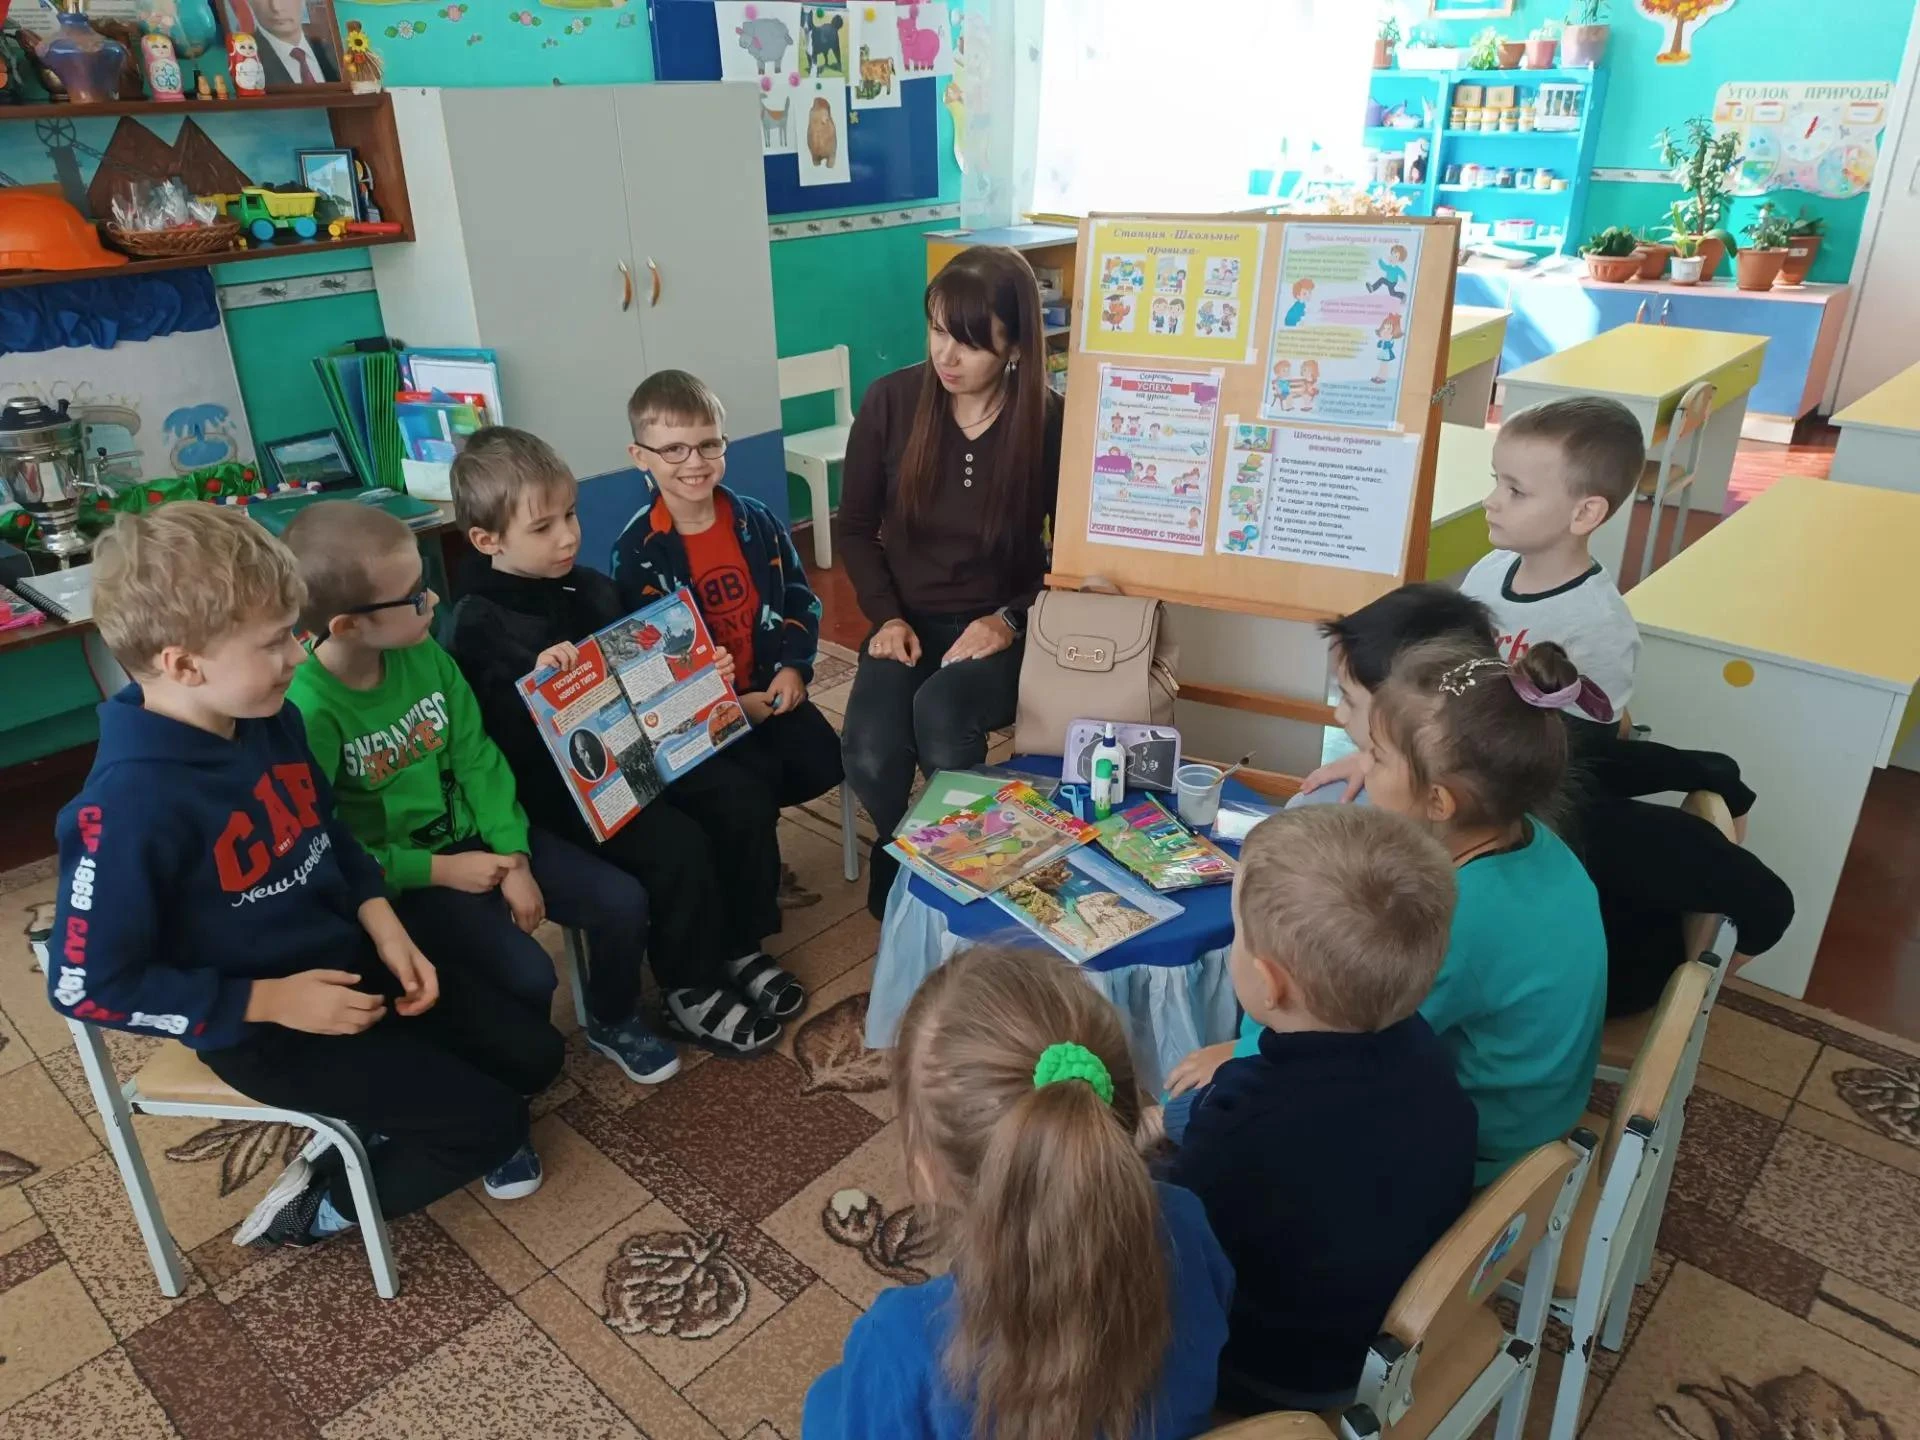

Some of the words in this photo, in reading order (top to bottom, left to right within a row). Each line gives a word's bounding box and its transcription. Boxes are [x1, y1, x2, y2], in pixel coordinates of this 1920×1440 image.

[1728, 87, 1790, 99] УГОЛОК
[1804, 86, 1889, 101] ПРИРОДЫ
[1137, 382, 1172, 392] УСПЕХА
[1293, 431, 1341, 443] Школьные
